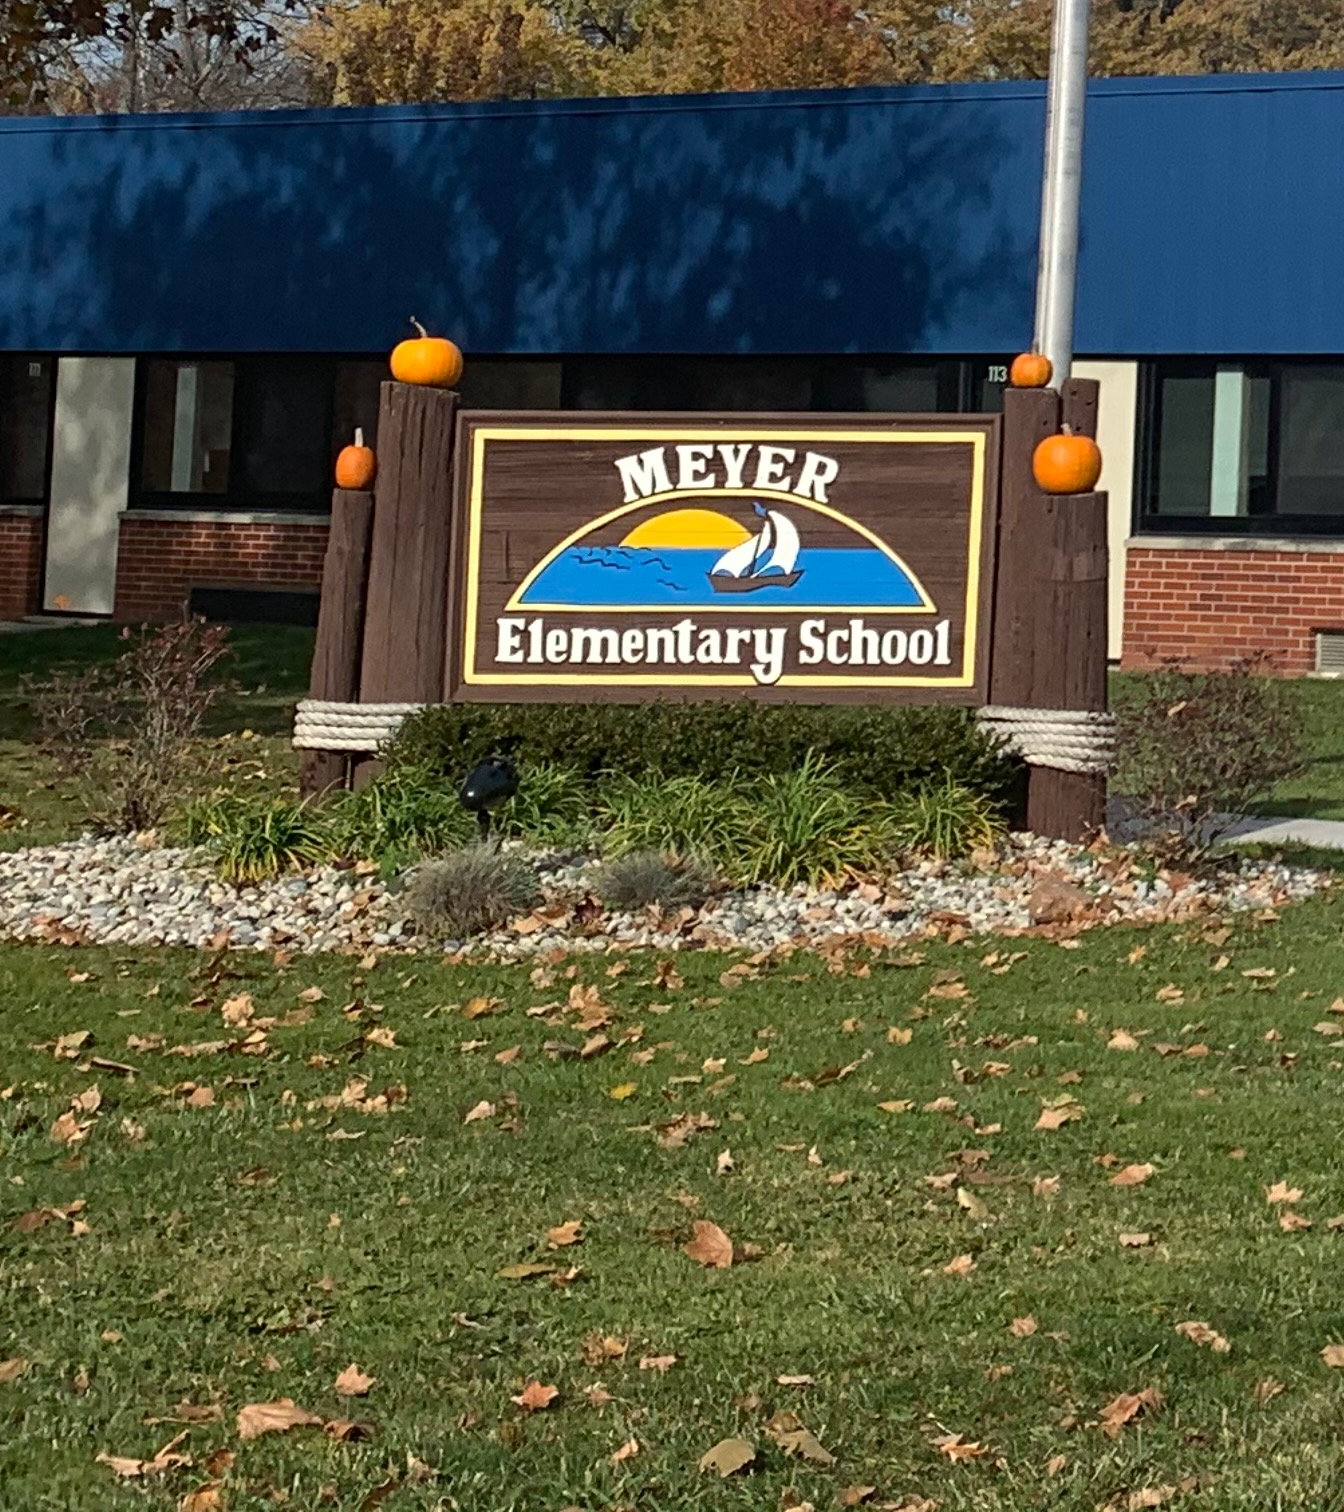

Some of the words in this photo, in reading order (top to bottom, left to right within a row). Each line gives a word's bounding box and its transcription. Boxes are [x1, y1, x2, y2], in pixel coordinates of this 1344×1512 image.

[988, 365, 1007, 383] 113
[614, 443, 840, 504] MEYER
[494, 617, 787, 687] Elementary
[798, 618, 952, 666] School
